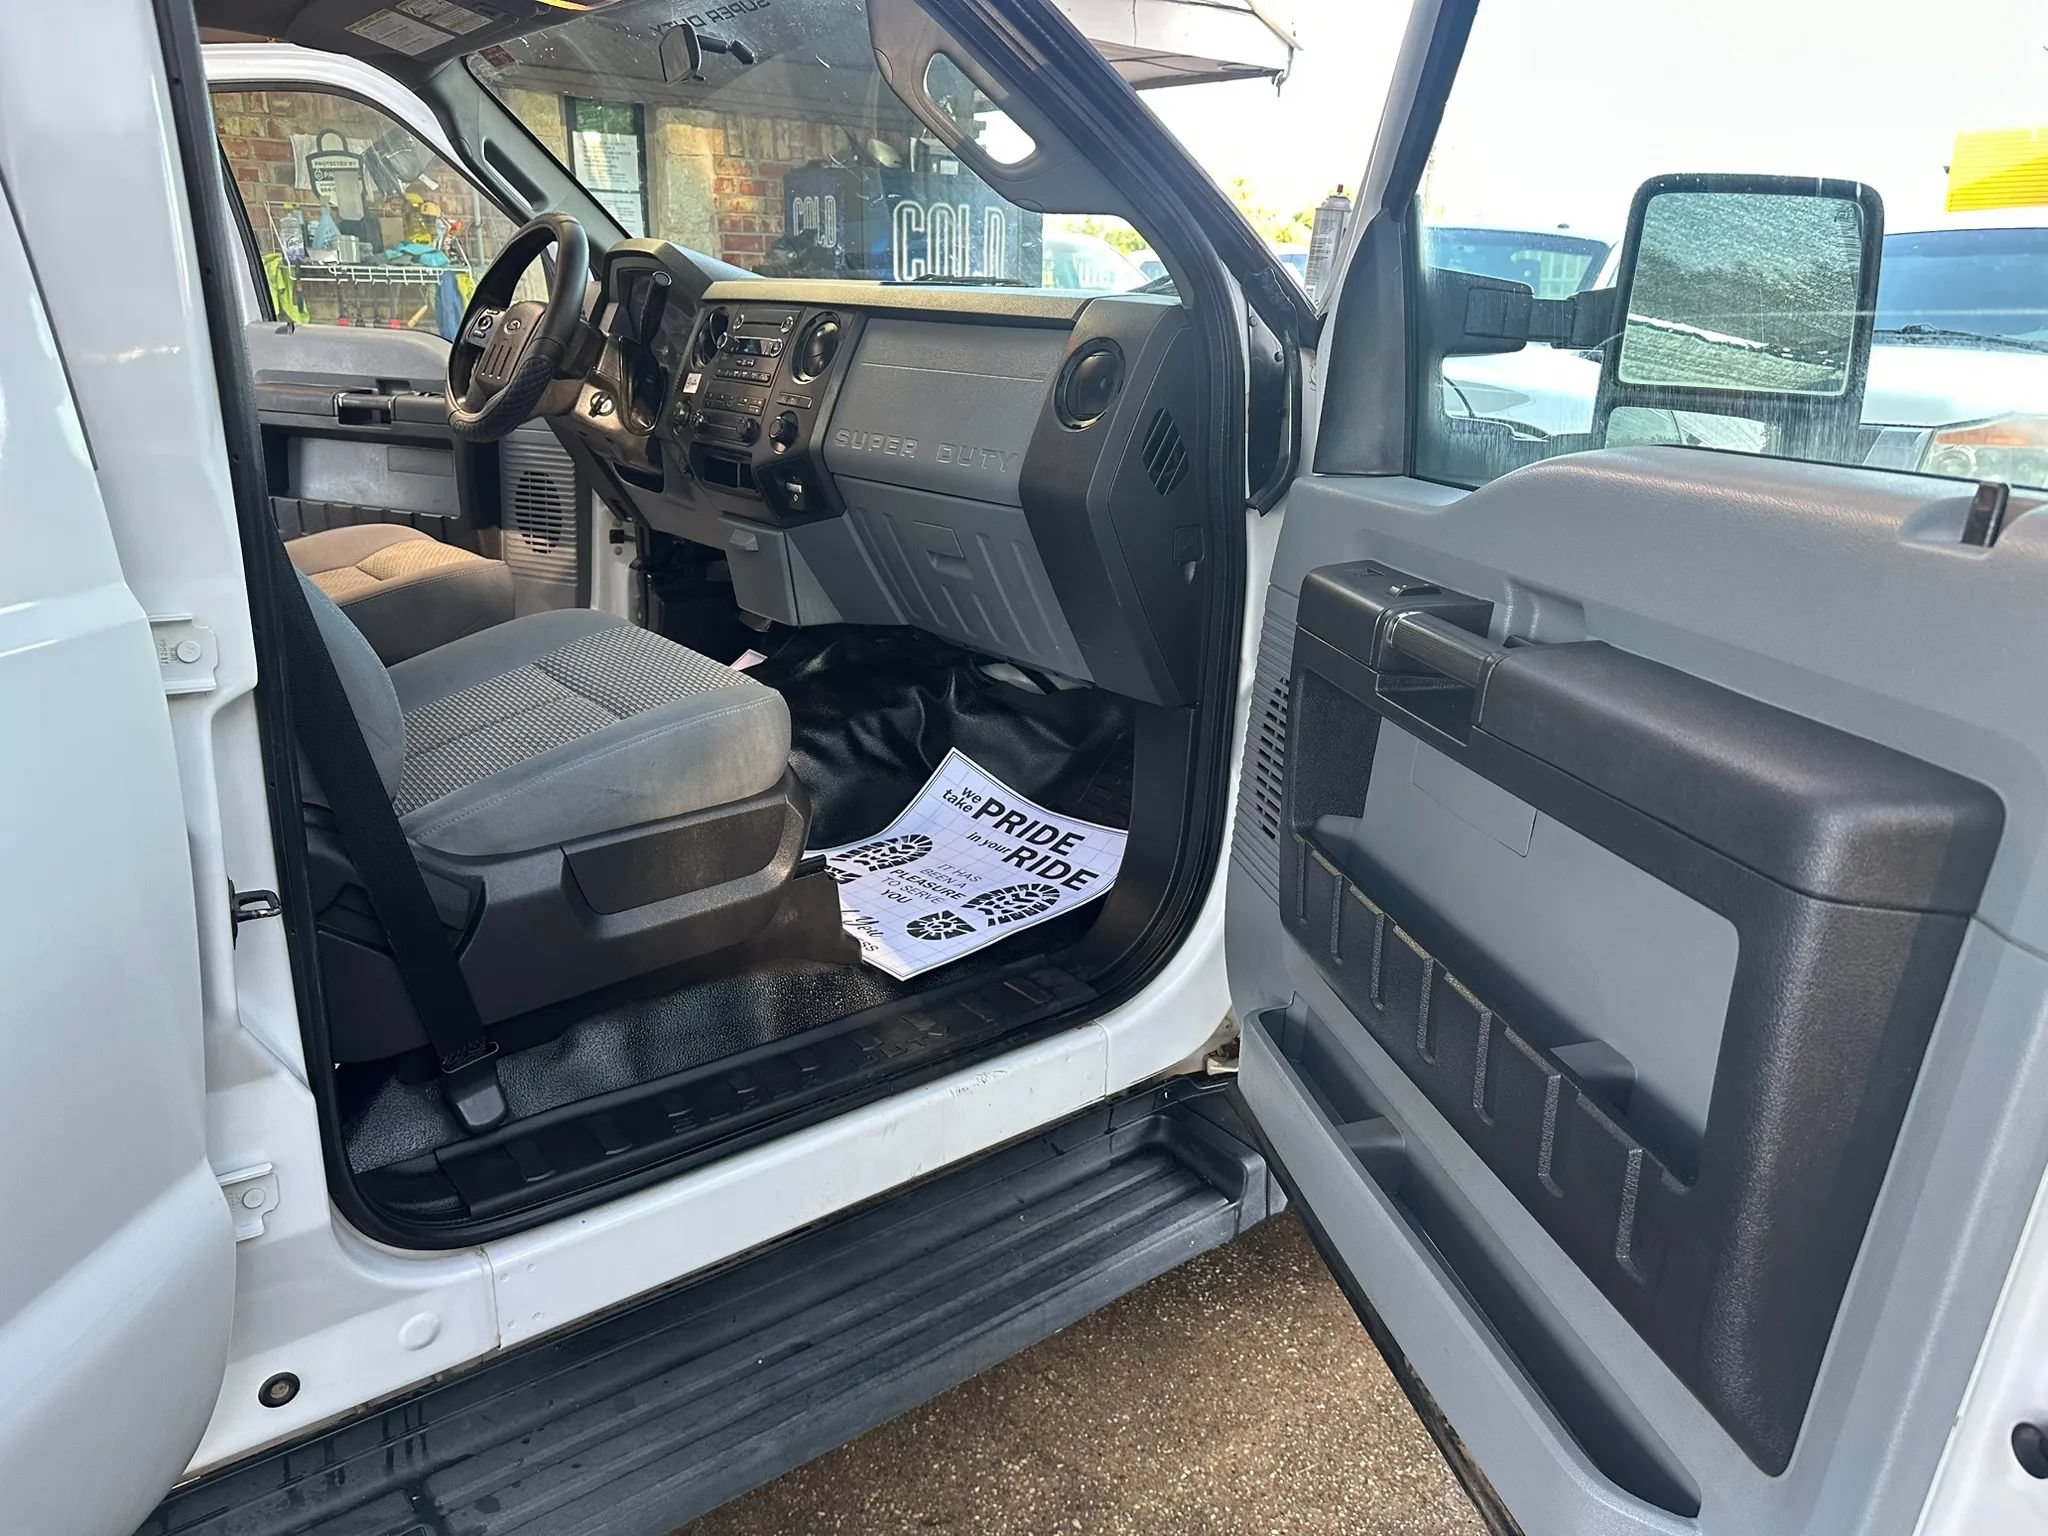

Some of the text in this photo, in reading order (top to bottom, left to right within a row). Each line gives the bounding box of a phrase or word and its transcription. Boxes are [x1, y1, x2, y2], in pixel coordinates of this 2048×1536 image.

[893, 200, 1006, 282] COLD
[834, 428, 1019, 472] SUPER DUTY
[961, 787, 982, 804] we
[942, 789, 1086, 857] take PRIDE
[920, 868, 957, 884] BEEN
[938, 863, 983, 882] IT HAS
[966, 832, 1100, 891] in your RIDE
[881, 889, 913, 904] YOU
[882, 876, 944, 904] TO SERVE
[890, 868, 967, 900] PLEASURE
